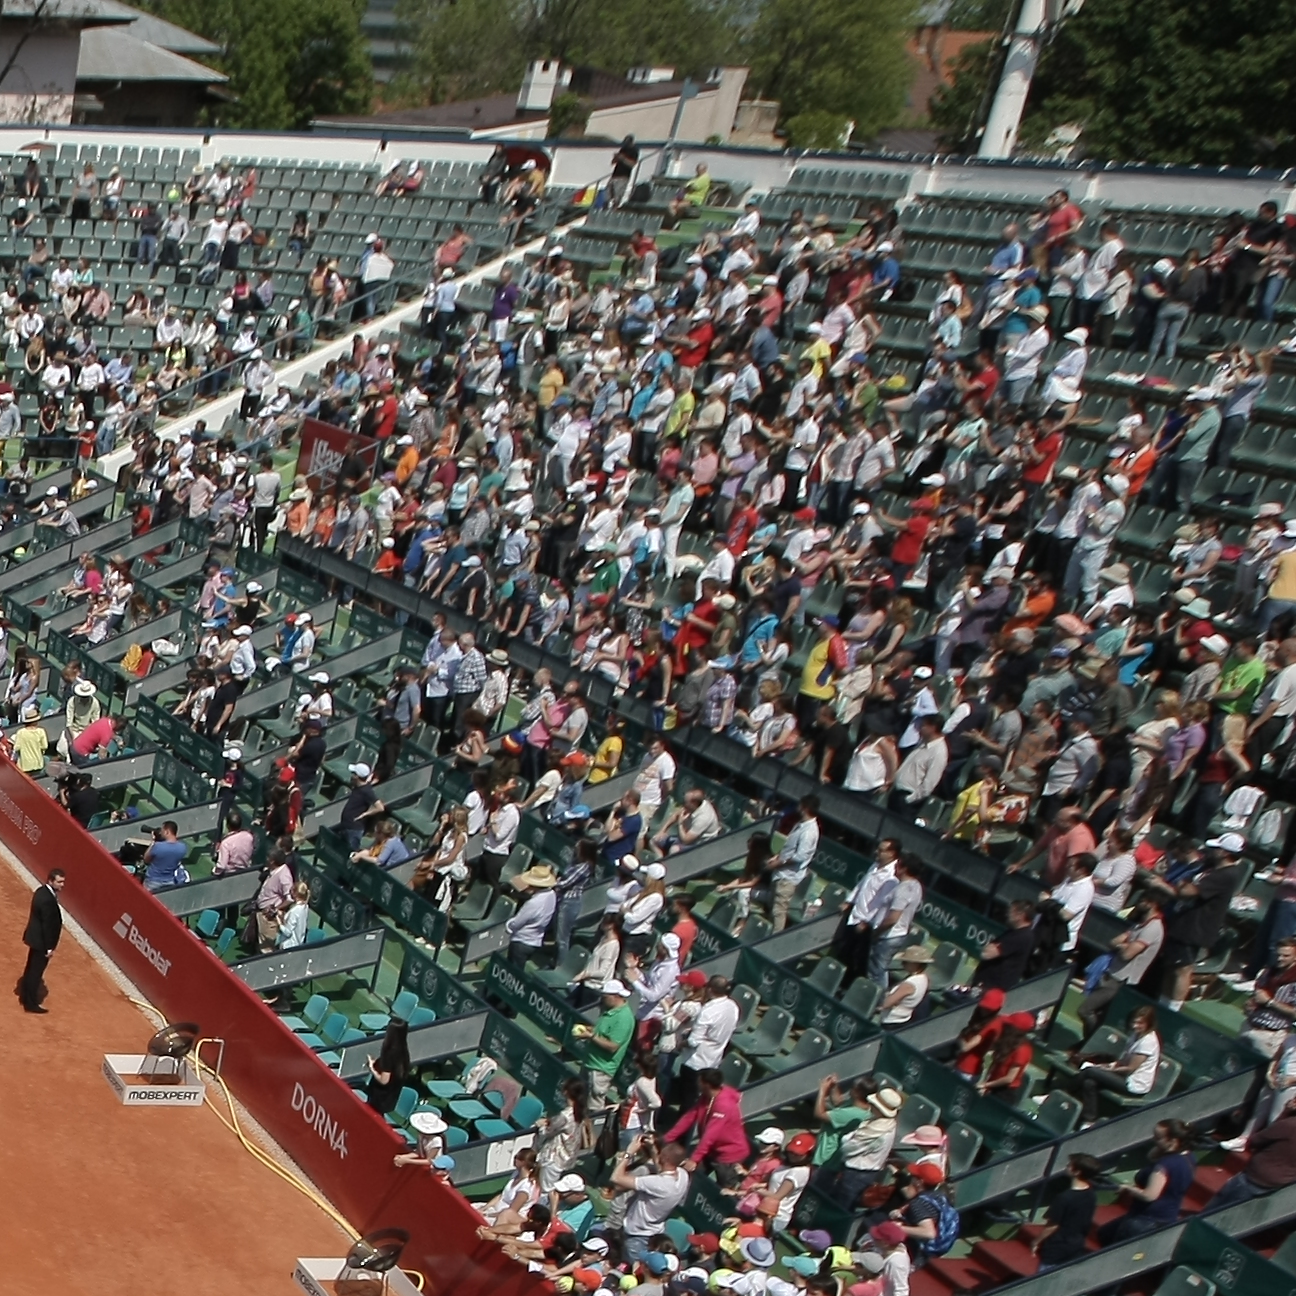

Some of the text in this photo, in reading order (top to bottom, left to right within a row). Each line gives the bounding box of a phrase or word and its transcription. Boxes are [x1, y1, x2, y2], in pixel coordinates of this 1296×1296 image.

[129, 925, 171, 976] Babolat
[493, 963, 526, 998] DORNA
[529, 991, 565, 1028] DORNA
[128, 1091, 199, 1101] MOBEXPERT
[291, 1082, 349, 1159] DORNA
